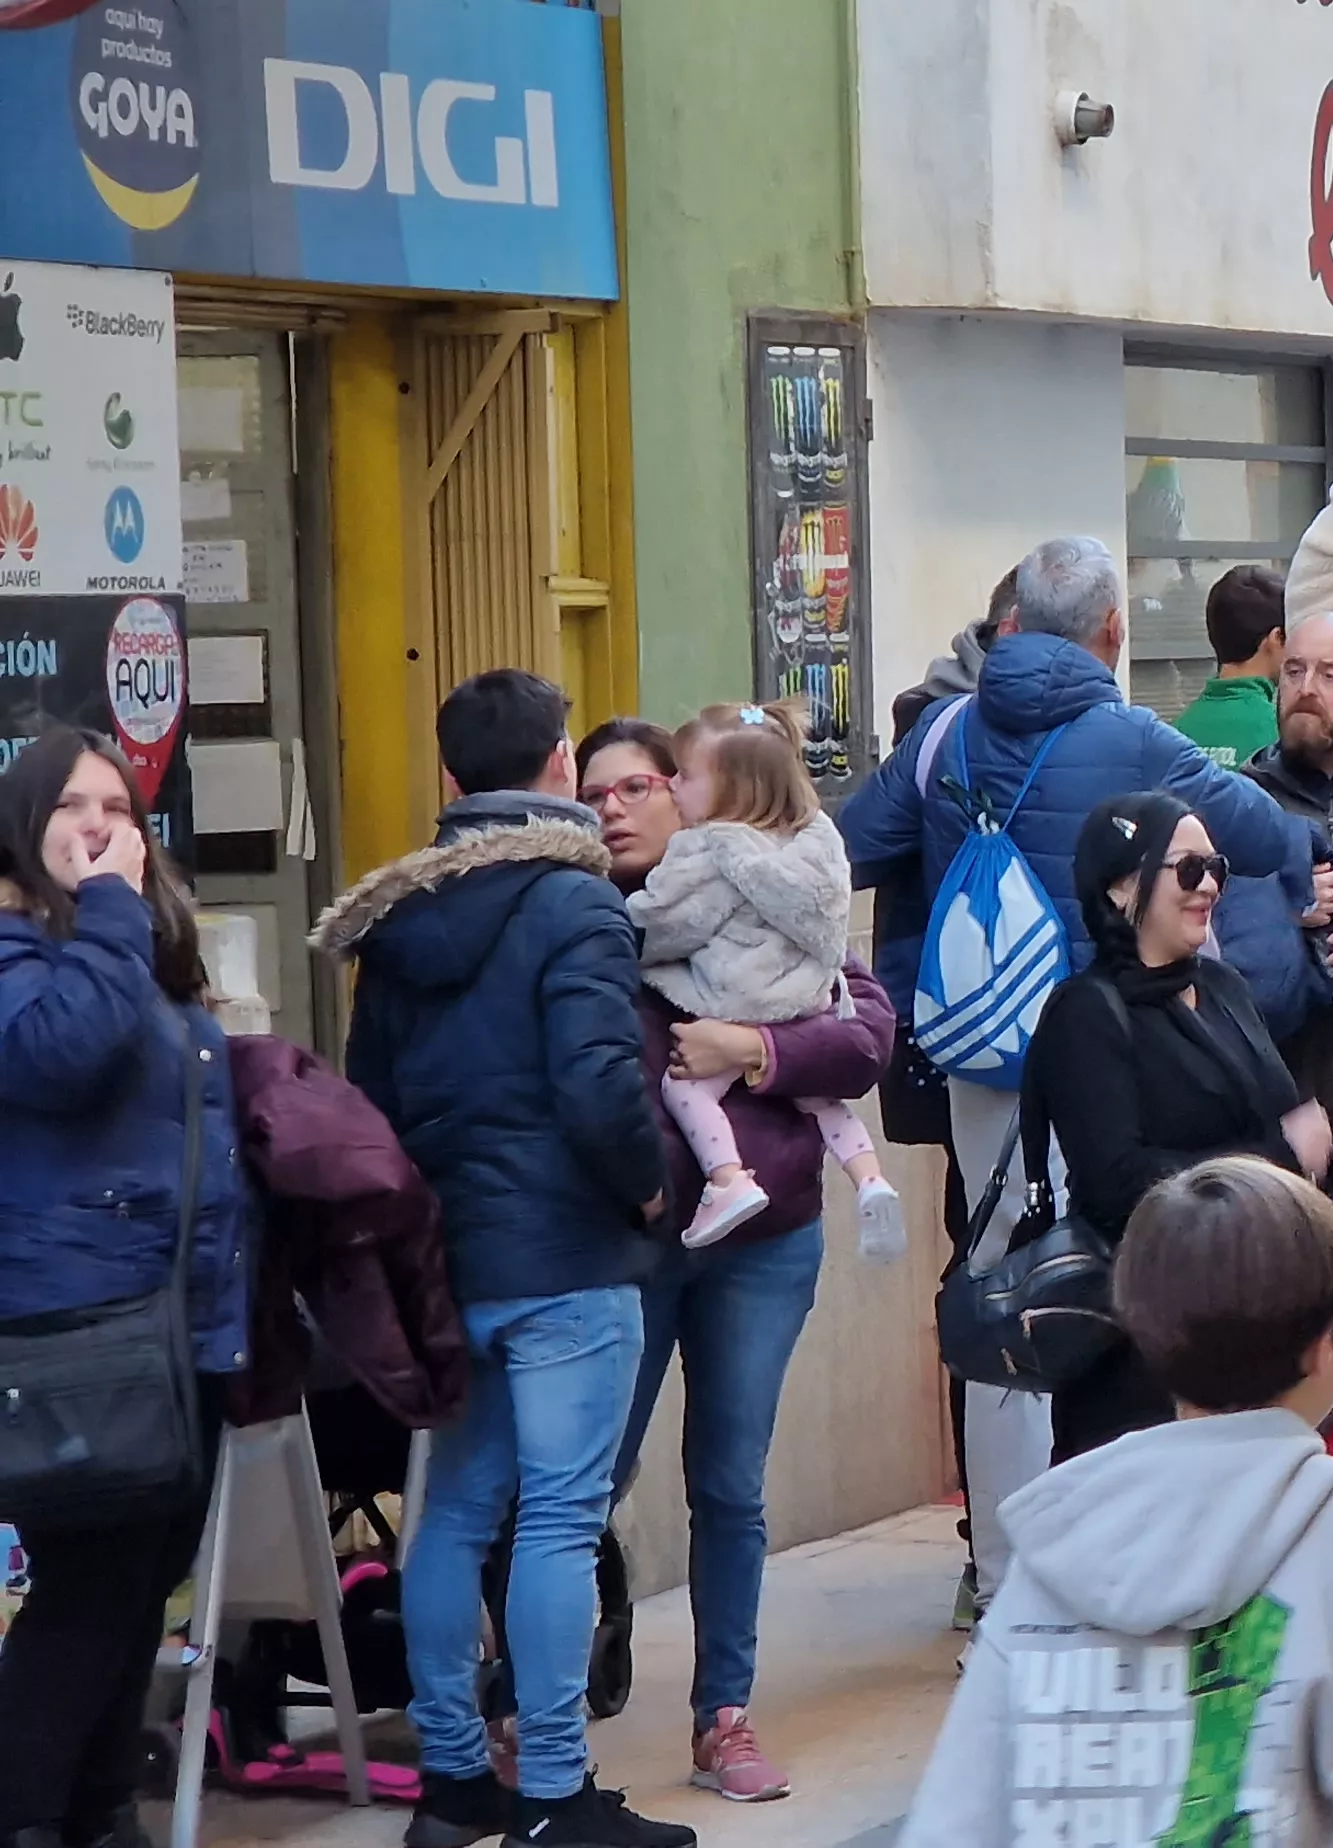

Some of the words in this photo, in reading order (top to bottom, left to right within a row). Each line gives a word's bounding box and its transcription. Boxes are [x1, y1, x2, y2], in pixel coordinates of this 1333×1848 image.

[101, 38, 172, 68] productos
[79, 71, 195, 148] GOYA
[263, 57, 558, 207] DIGI
[85, 310, 165, 344] BlackBerry
[86, 576, 165, 590] MOTOROLA
[0, 631, 58, 677] IÓN
[113, 631, 174, 655] RECARGA
[116, 658, 175, 709] AQUI
